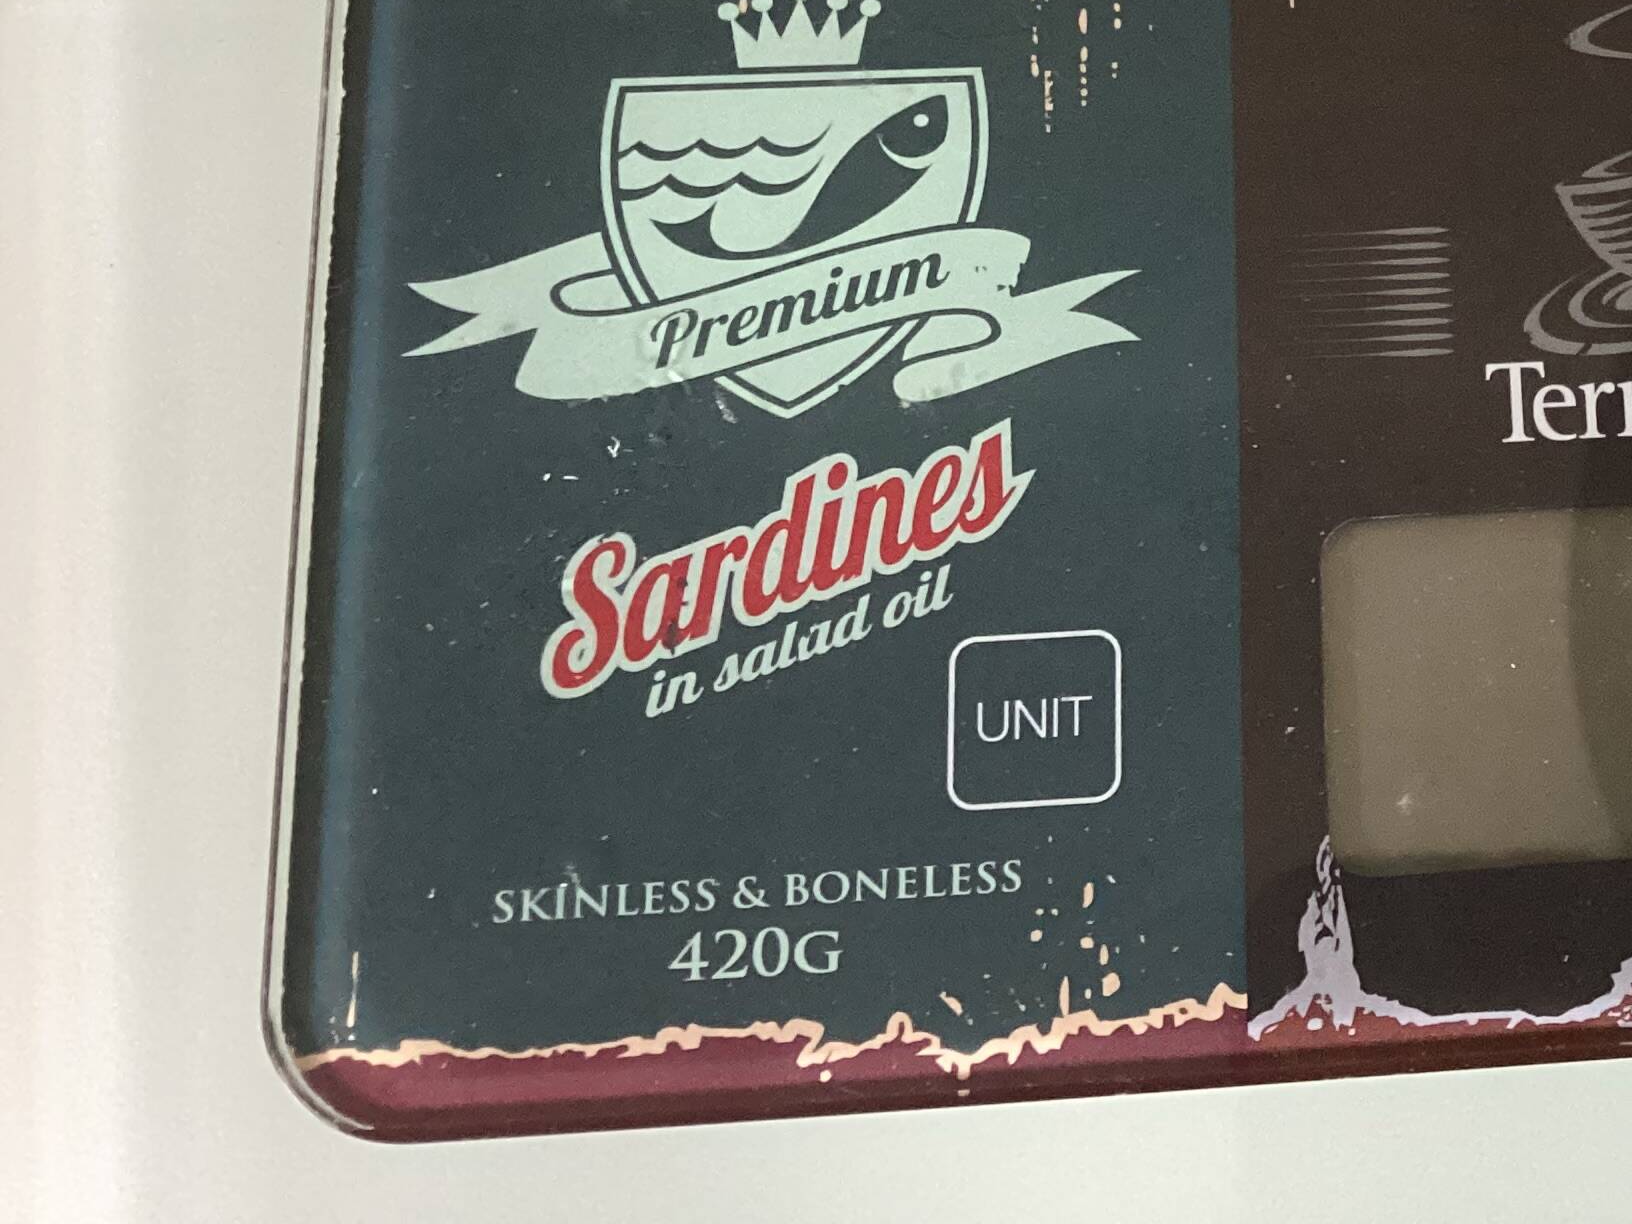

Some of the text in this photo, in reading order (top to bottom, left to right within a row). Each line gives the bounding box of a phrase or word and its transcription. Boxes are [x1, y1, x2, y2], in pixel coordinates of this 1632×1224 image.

[649, 251, 950, 370] Premium
[540, 417, 1036, 699] Sardines
[644, 563, 955, 719] in salad oil
[975, 694, 1093, 743] UNIT
[491, 858, 1024, 924] SKINLESS & BONELESS
[667, 925, 844, 983] 420G
